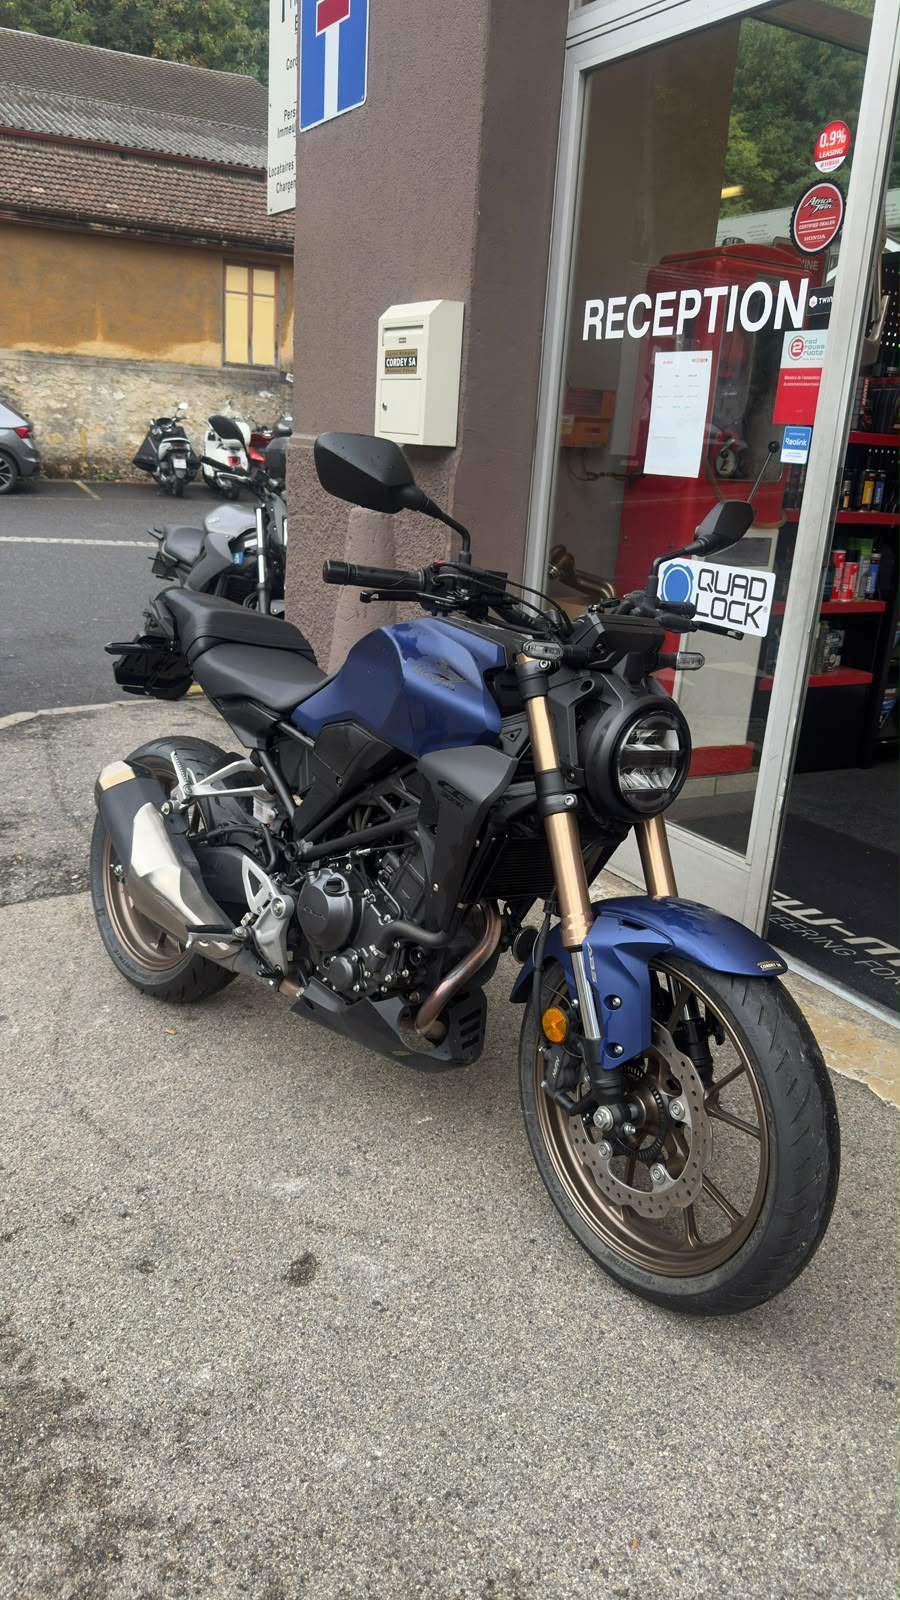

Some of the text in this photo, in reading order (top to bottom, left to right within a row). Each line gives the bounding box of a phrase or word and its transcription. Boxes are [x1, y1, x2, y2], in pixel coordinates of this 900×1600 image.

[819, 128, 846, 148] 0.9%
[818, 147, 844, 159] LEASING
[269, 160, 294, 178] Locataires
[803, 196, 832, 208] Africa
[811, 204, 832, 215] Twin
[799, 222, 819, 230] CERTIFIED
[803, 234, 826, 242] HONDA
[583, 278, 809, 341] RECEPTION
[386, 357, 416, 368] CORDEY SA
[785, 437, 808, 447] Reolink
[698, 568, 767, 602] QUAD
[694, 593, 763, 629] LOCK
